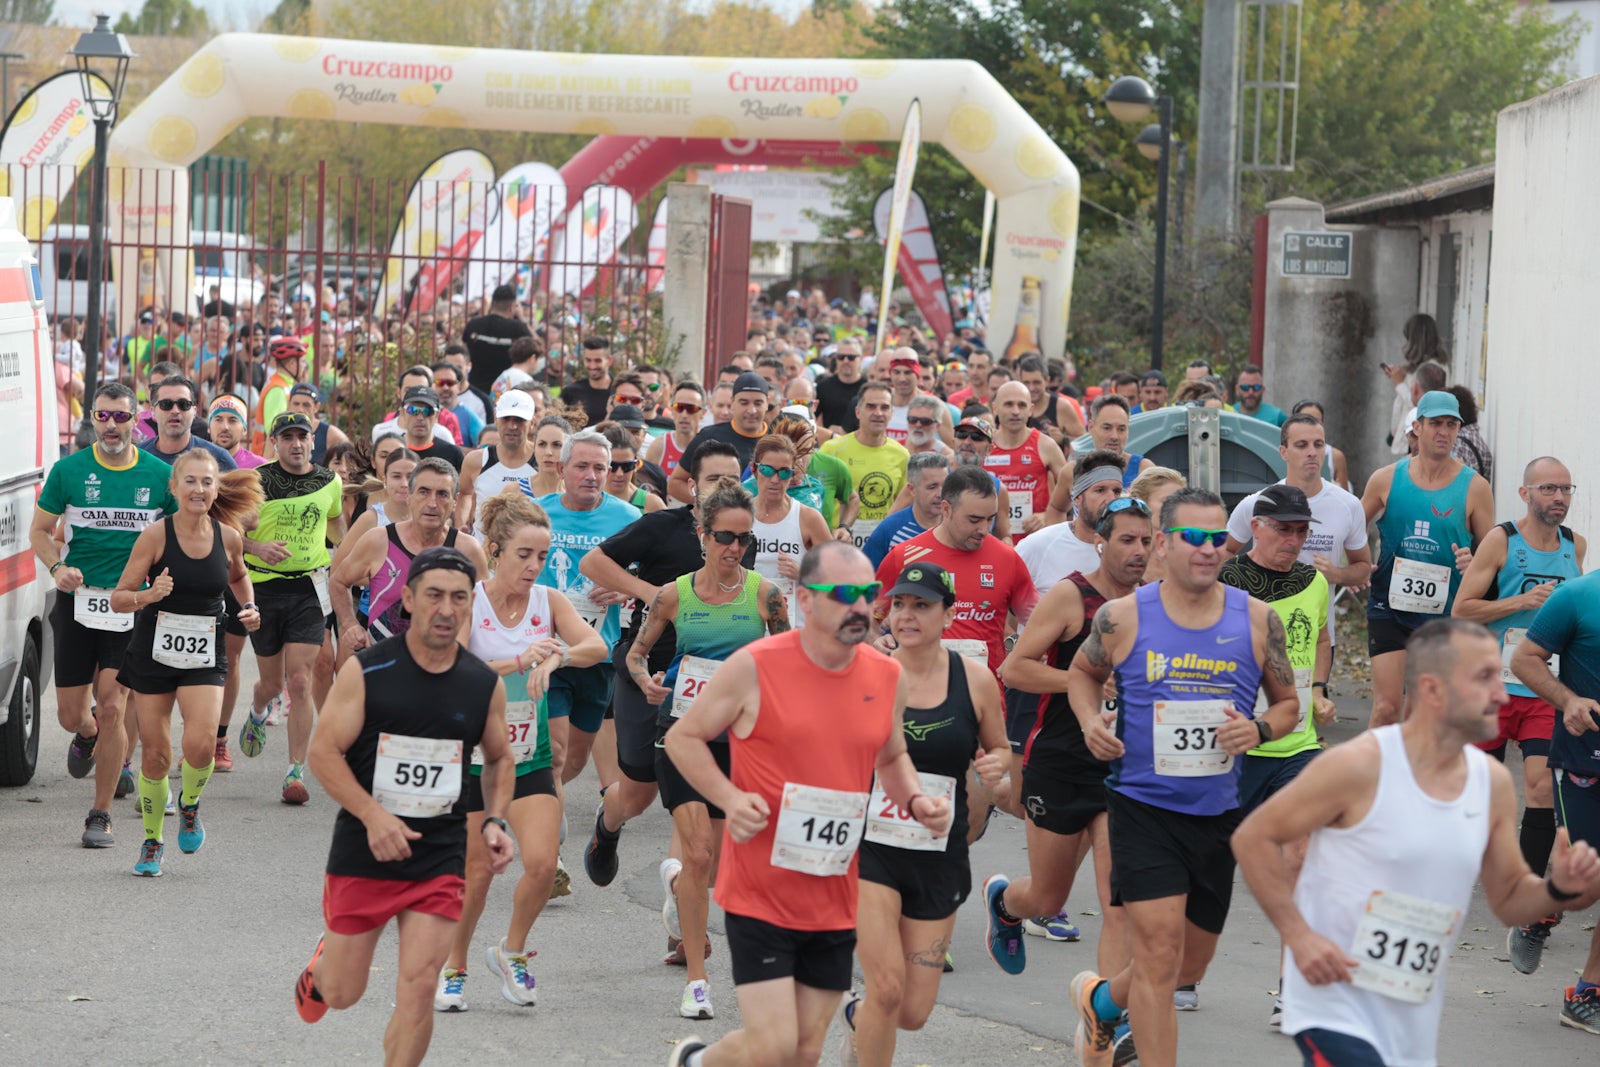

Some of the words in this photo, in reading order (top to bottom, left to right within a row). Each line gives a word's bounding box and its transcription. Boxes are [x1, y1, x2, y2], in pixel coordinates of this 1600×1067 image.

[322, 54, 453, 83] Cruzcampo
[334, 82, 397, 105] Radler
[560, 75, 620, 93] NATURAL
[626, 77, 643, 94] DE
[728, 71, 859, 96] Cruzcampo
[485, 91, 583, 113] DOBLEMENTE
[587, 96, 691, 115] REFRESCANTE
[740, 99, 803, 121] Radler
[19, 97, 81, 170] Cruzcampo
[1305, 236, 1344, 249] CALLE
[81, 510, 110, 520] CAJA
[113, 511, 150, 522] RURAL
[282, 504, 296, 515] XI
[95, 520, 136, 529] GRANADA
[274, 533, 315, 545] ROMANA
[1401, 541, 1440, 552] INNOVENT
[1402, 578, 1436, 598] 330
[87, 598, 110, 614] 58
[161, 633, 208, 655] 3032
[1171, 653, 1237, 676] olimpo
[1290, 655, 1311, 666] ANA
[1168, 670, 1211, 680] deportes
[1170, 685, 1191, 693] TRAIL
[1173, 727, 1218, 751] 337
[394, 763, 444, 789] 597
[802, 817, 850, 846] 146
[1366, 930, 1441, 974] 3139
